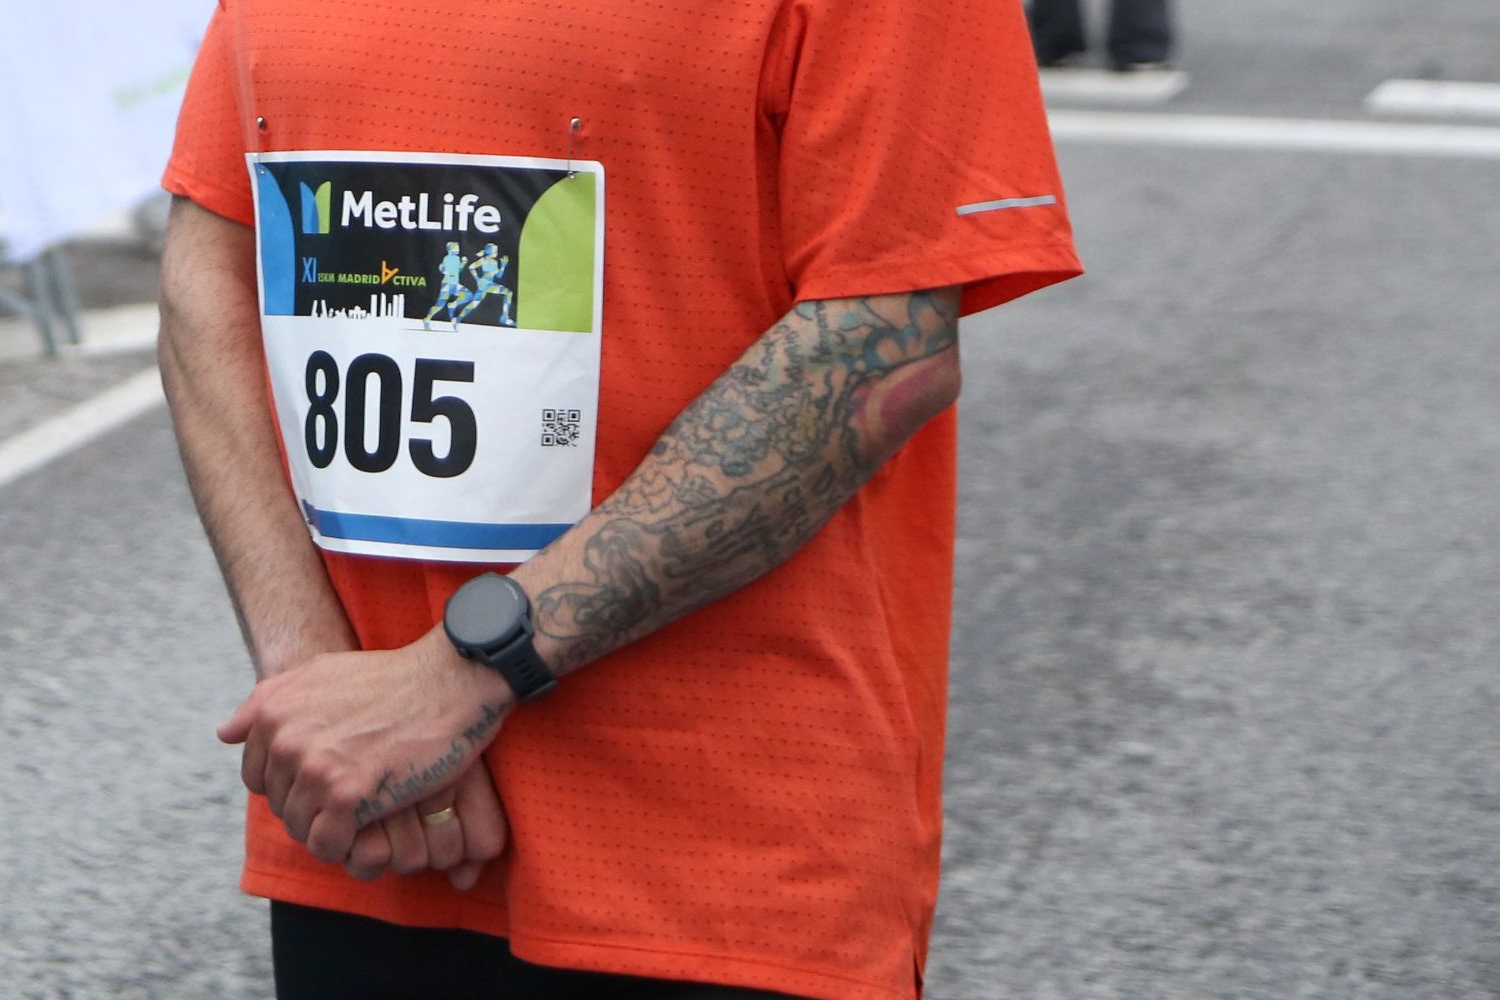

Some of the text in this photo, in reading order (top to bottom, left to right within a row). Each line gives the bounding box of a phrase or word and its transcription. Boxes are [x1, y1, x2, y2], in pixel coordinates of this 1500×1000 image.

[341, 190, 501, 233] MetLife
[302, 257, 317, 283] XI
[305, 350, 478, 479] 805
